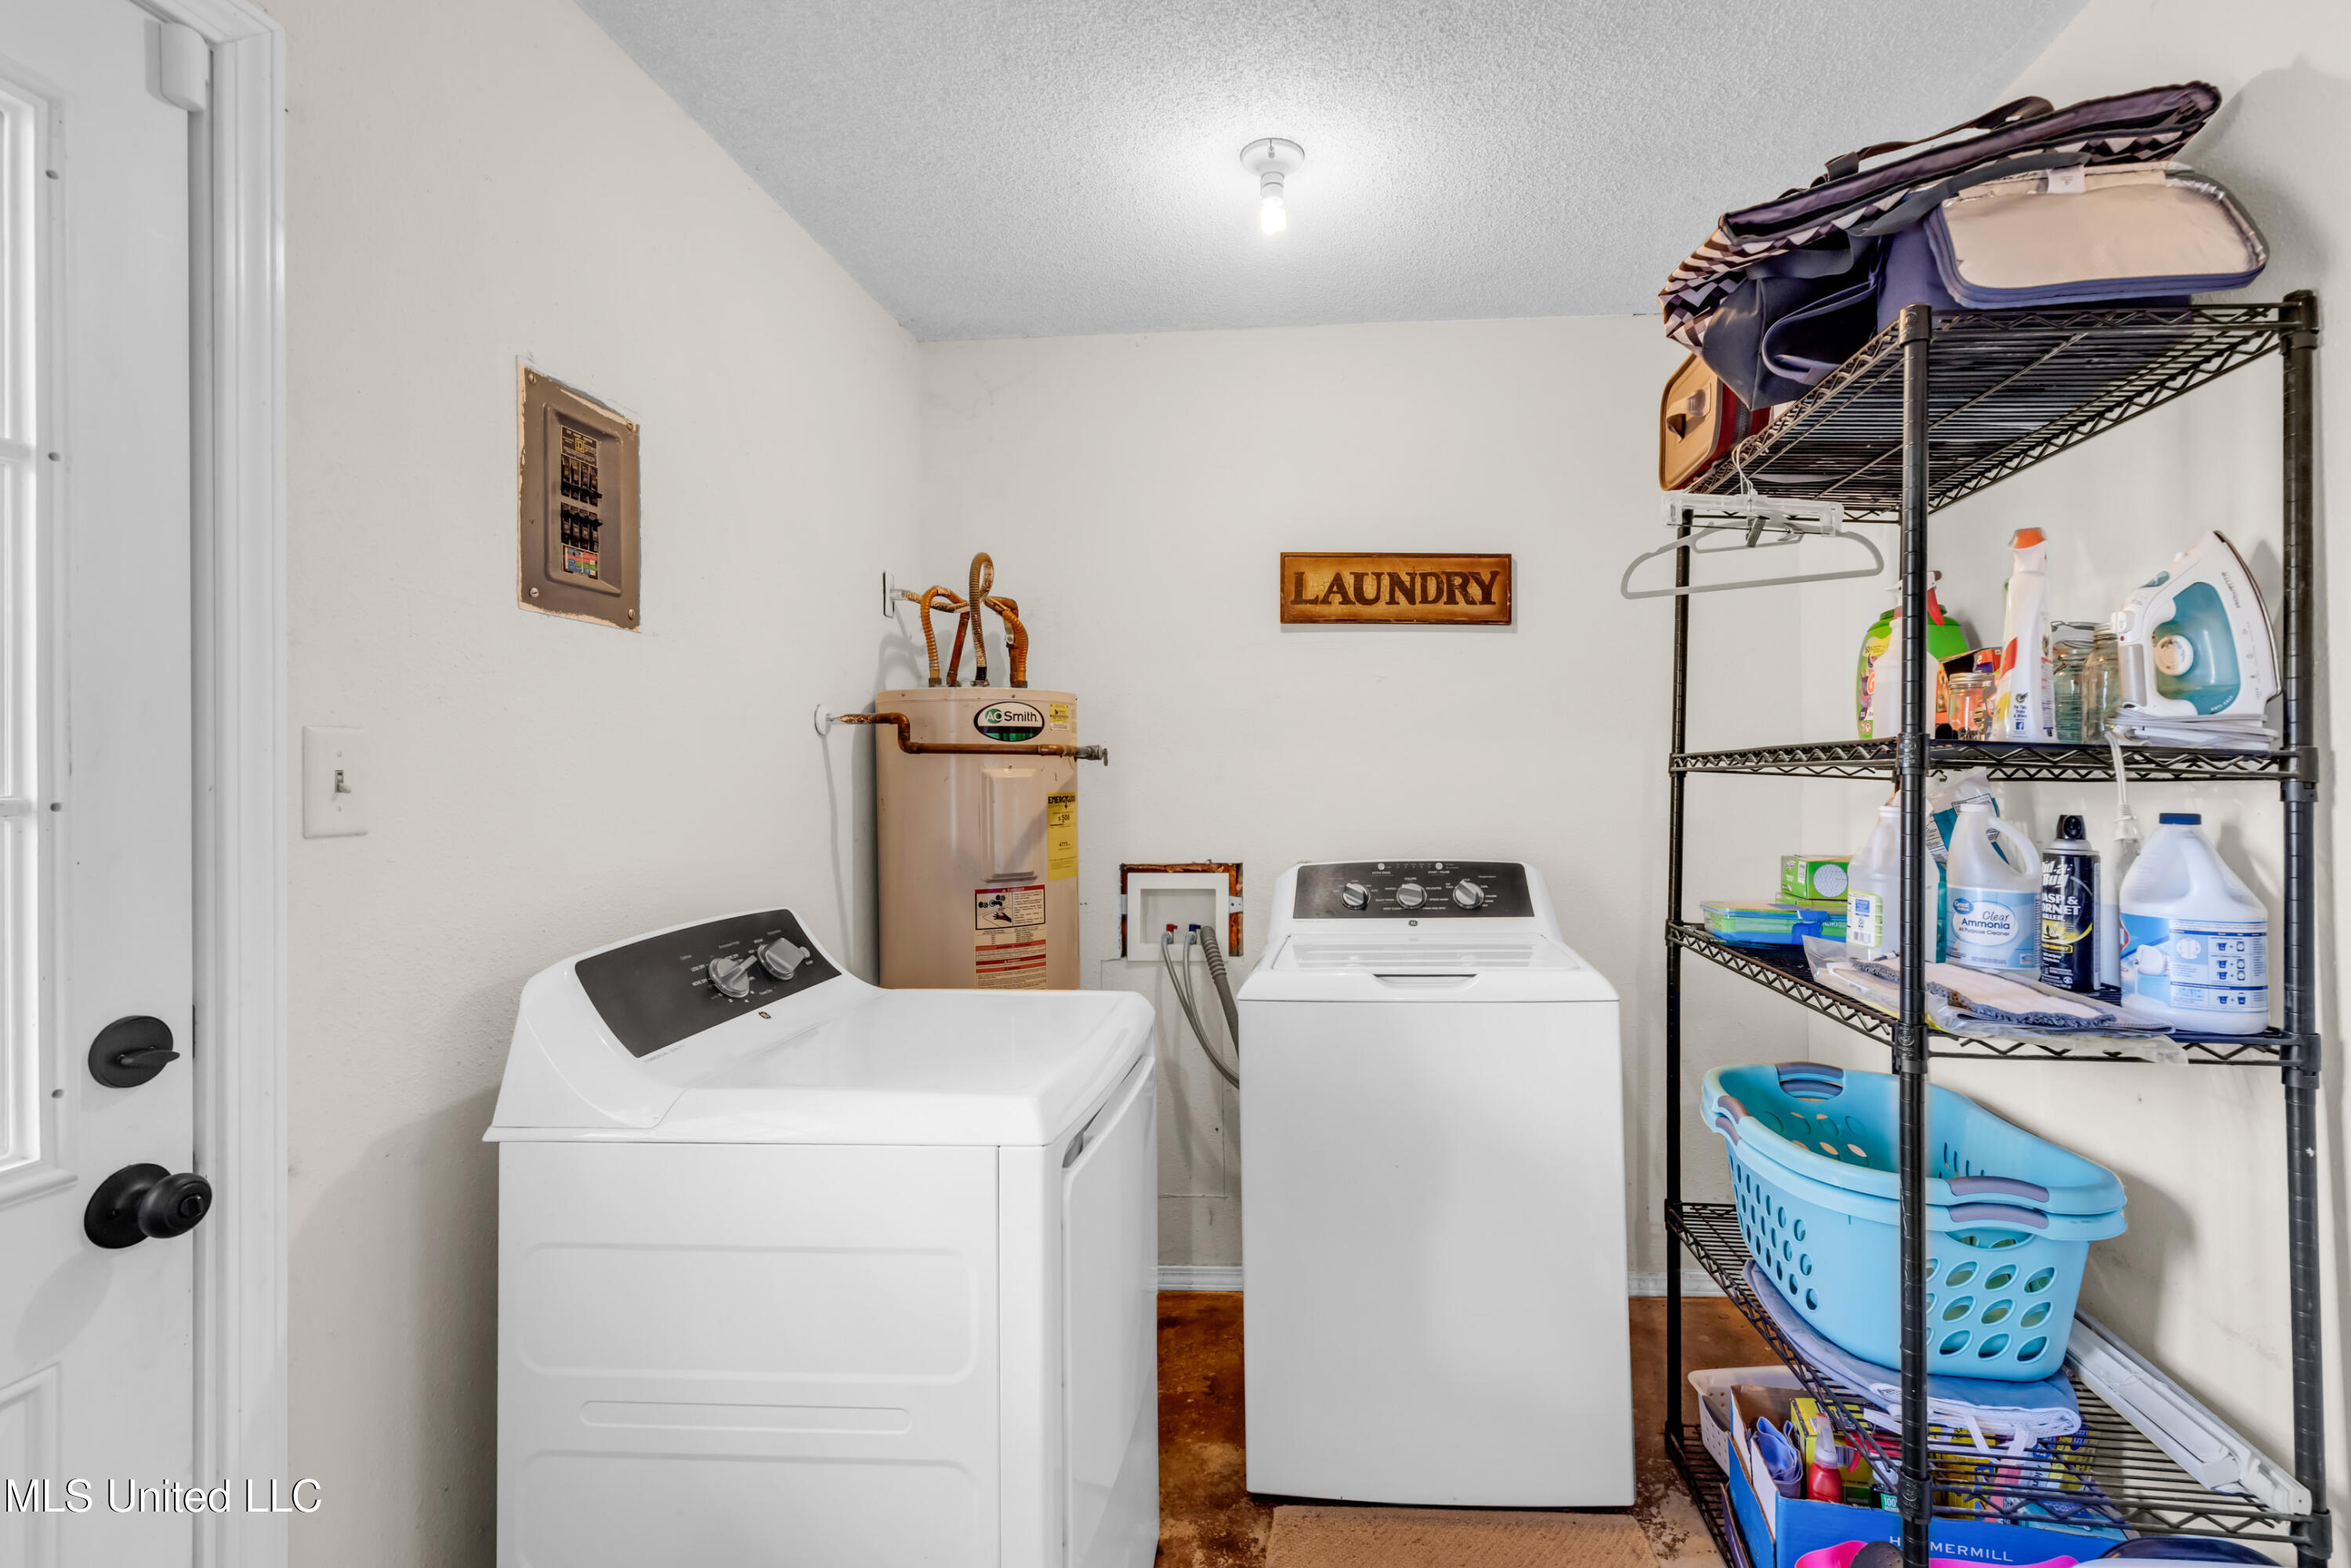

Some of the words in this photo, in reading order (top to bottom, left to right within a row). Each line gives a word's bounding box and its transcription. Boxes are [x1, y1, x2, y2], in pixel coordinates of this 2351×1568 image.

[1290, 570, 1501, 606] LAUNDRY
[1004, 711, 1037, 722] Smith
[2041, 893, 2064, 904] ASP
[2067, 896, 2078, 905] &
[2041, 902, 2081, 915] ORNET
[1982, 911, 2011, 922] Clear
[1962, 918, 2010, 930] Ammonia
[1889, 1536, 2013, 1563] HMERMILL
